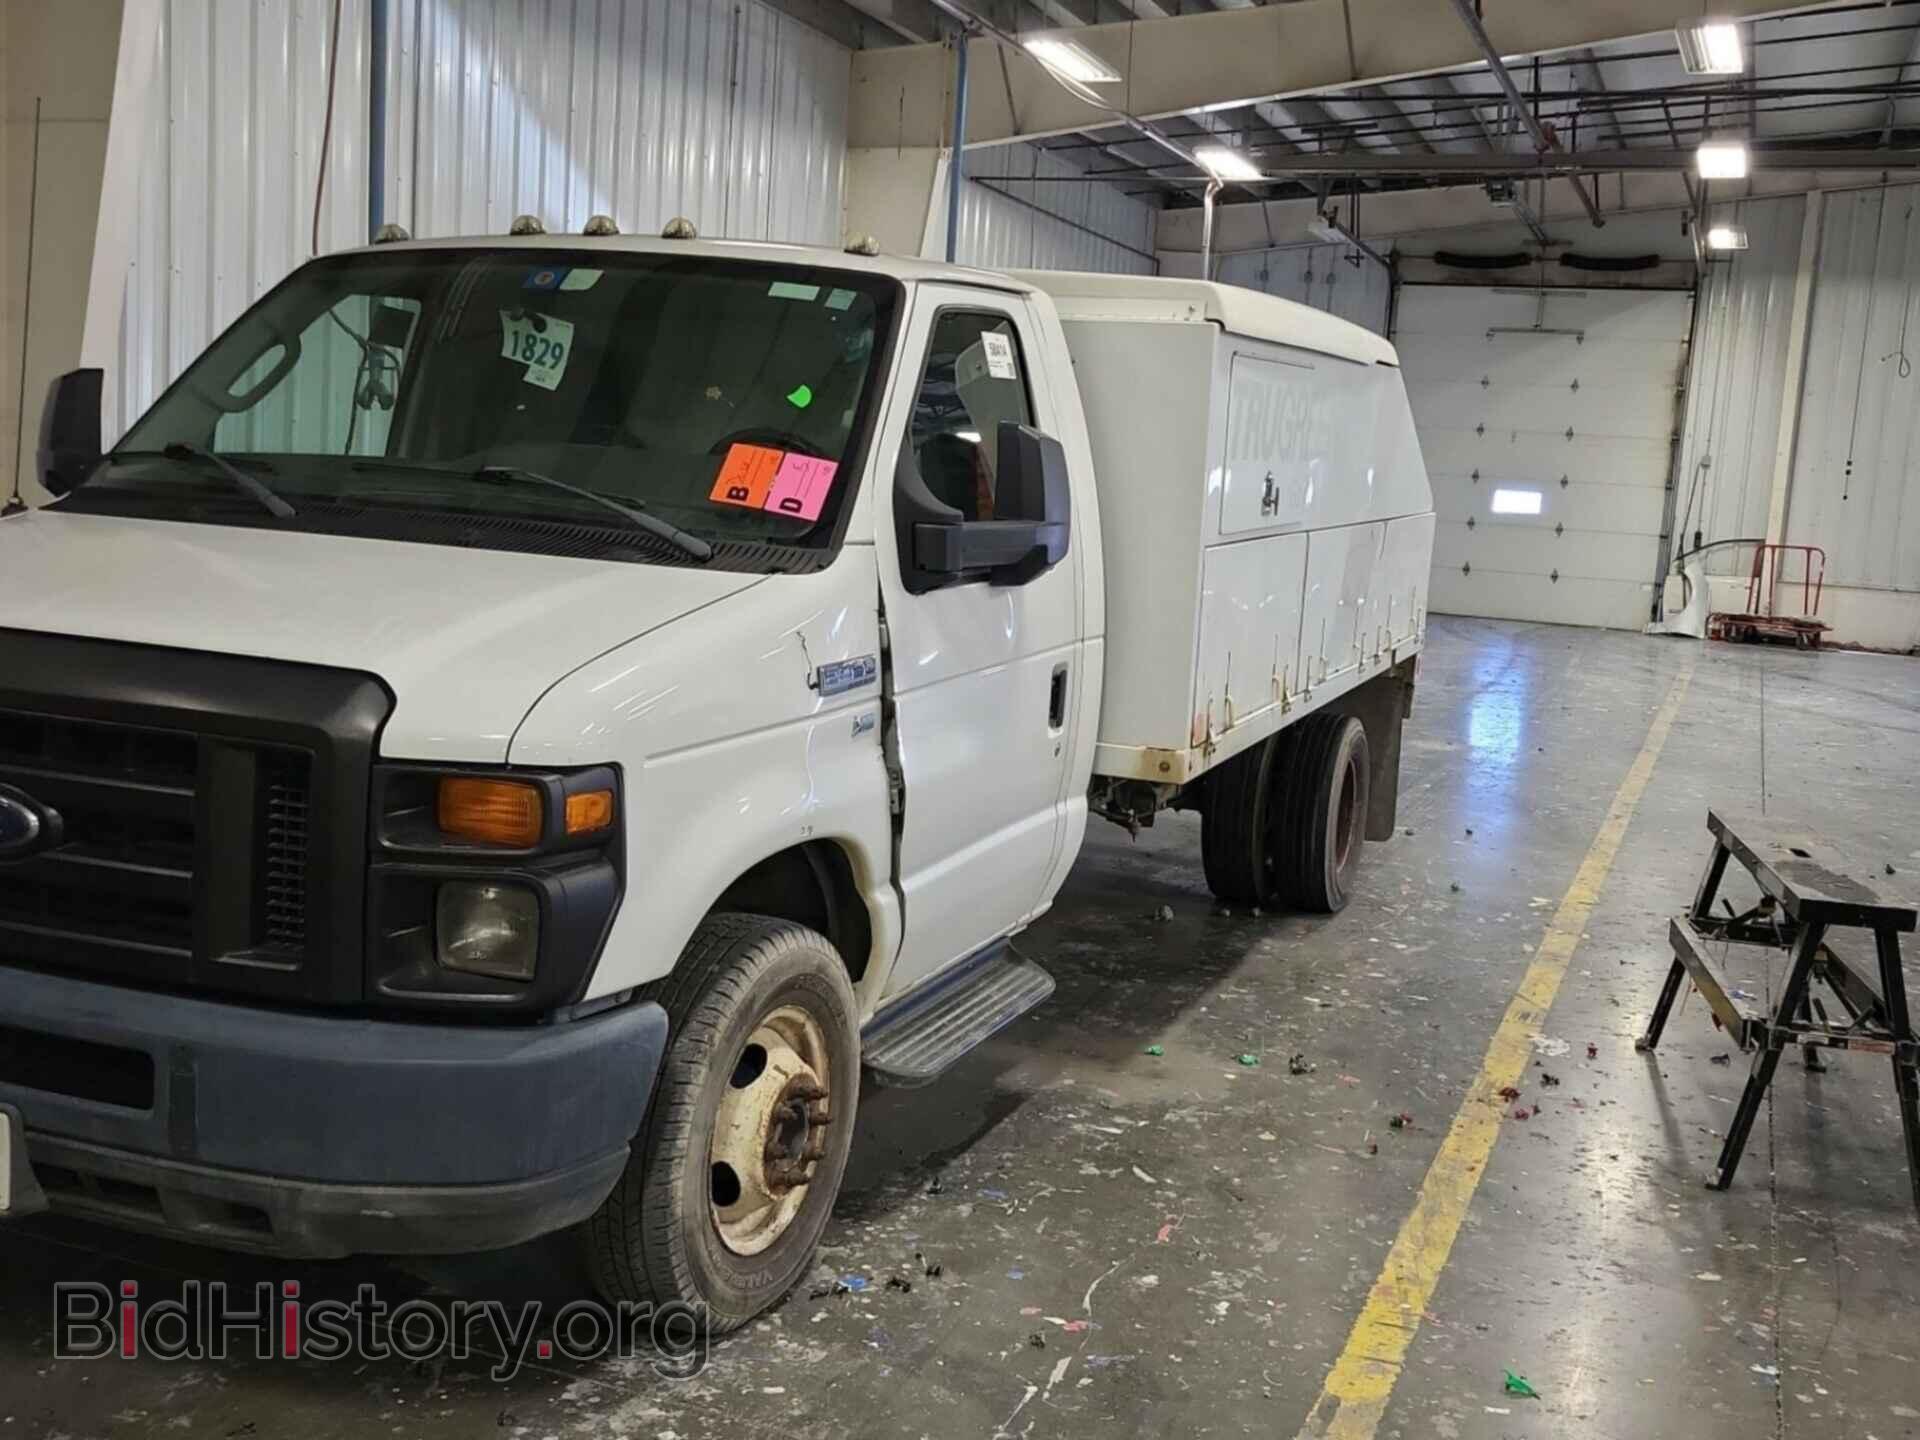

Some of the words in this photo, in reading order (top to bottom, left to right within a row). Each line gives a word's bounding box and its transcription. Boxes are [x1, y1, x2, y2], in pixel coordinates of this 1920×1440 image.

[510, 329, 565, 371] 1829
[727, 486, 749, 501] B
[780, 497, 802, 513] D
